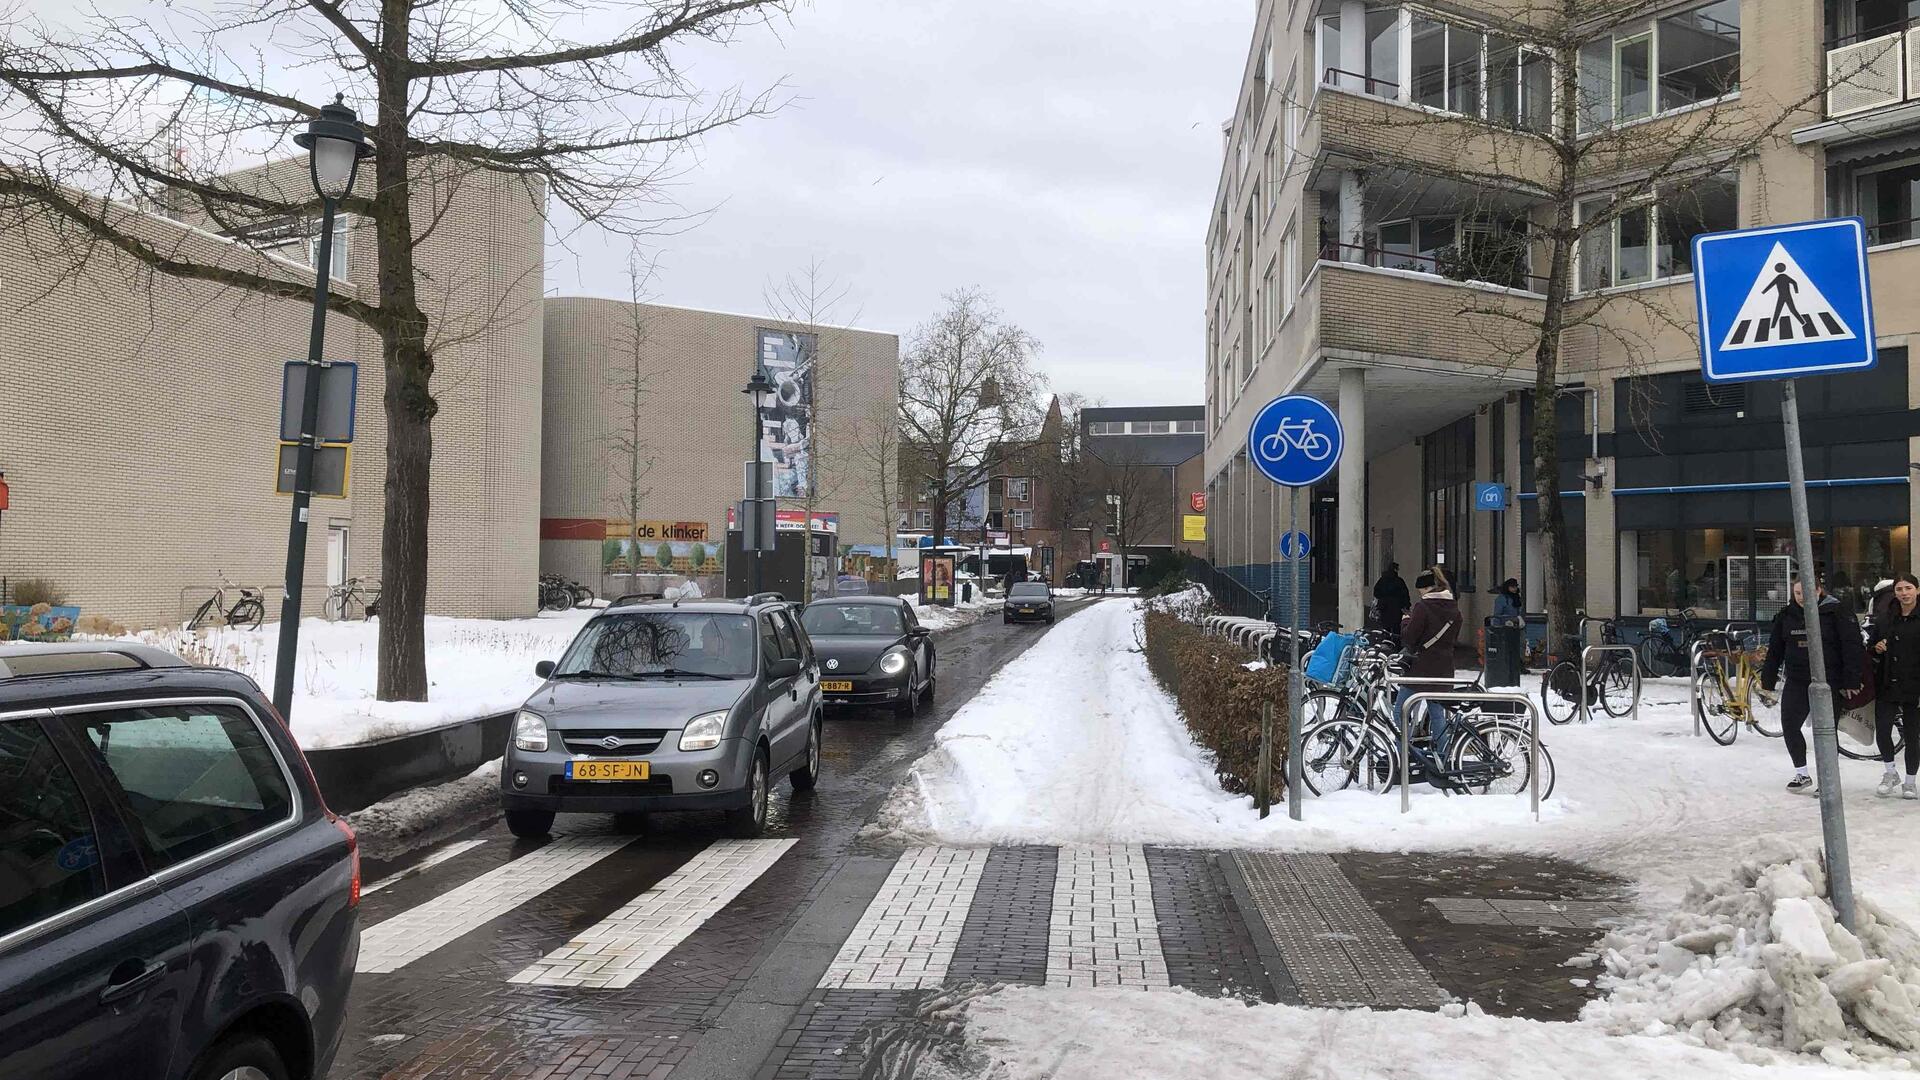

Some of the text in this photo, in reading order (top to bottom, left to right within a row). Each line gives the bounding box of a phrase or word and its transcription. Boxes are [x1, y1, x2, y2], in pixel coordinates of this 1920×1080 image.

[637, 524, 705, 539] de klinker
[819, 682, 849, 690] N-887-R
[579, 764, 643, 777] 68-SF-JN
